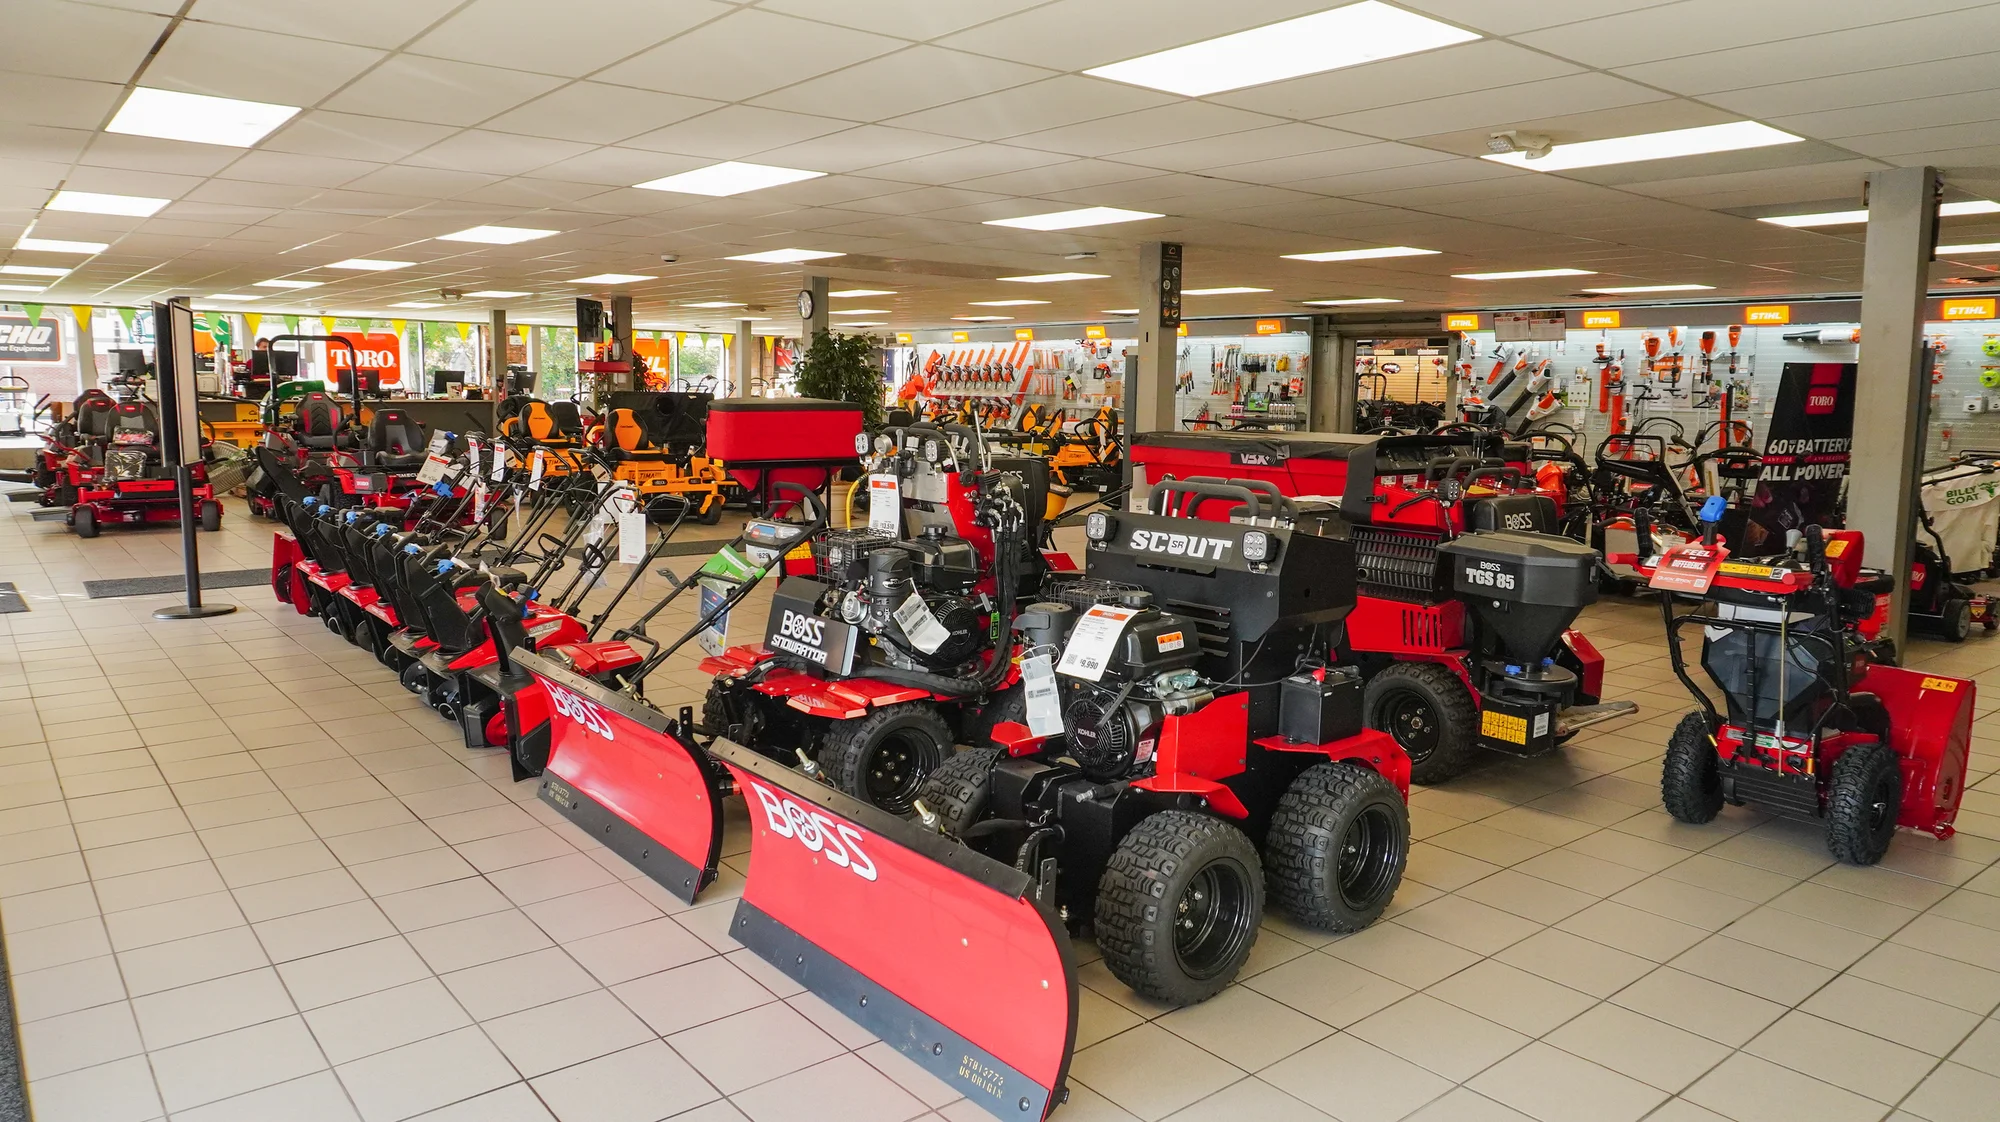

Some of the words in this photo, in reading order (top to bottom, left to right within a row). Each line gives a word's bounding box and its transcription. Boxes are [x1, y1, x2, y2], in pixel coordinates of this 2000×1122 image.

[1750, 312, 1782, 320] STIHL
[1948, 306, 1987, 315] STIHL
[331, 349, 394, 368] TORO
[1809, 396, 1834, 406] TORO
[1796, 438, 1851, 454] BATTERY
[1759, 466, 1791, 481] ALL
[1794, 463, 1845, 480] POWER
[1946, 486, 1976, 498] BILLY
[1946, 493, 1979, 505] GOAT
[1504, 512, 1533, 530] BOSS
[1130, 530, 1233, 560] SCOUT
[1171, 540, 1185, 549] SR
[1682, 549, 1710, 557] FEEL
[1480, 561, 1501, 572] BOSS
[1466, 567, 1495, 587] TGS
[1496, 572, 1515, 590] 85
[780, 609, 826, 647] BOSS
[538, 676, 614, 741] BOSS
[1077, 727, 1097, 739] KOHLER
[751, 781, 877, 881] BOSS
[962, 1055, 1004, 1086] STB13773
[959, 1065, 971, 1079] US
[971, 1073, 1003, 1099] ORIGIN
